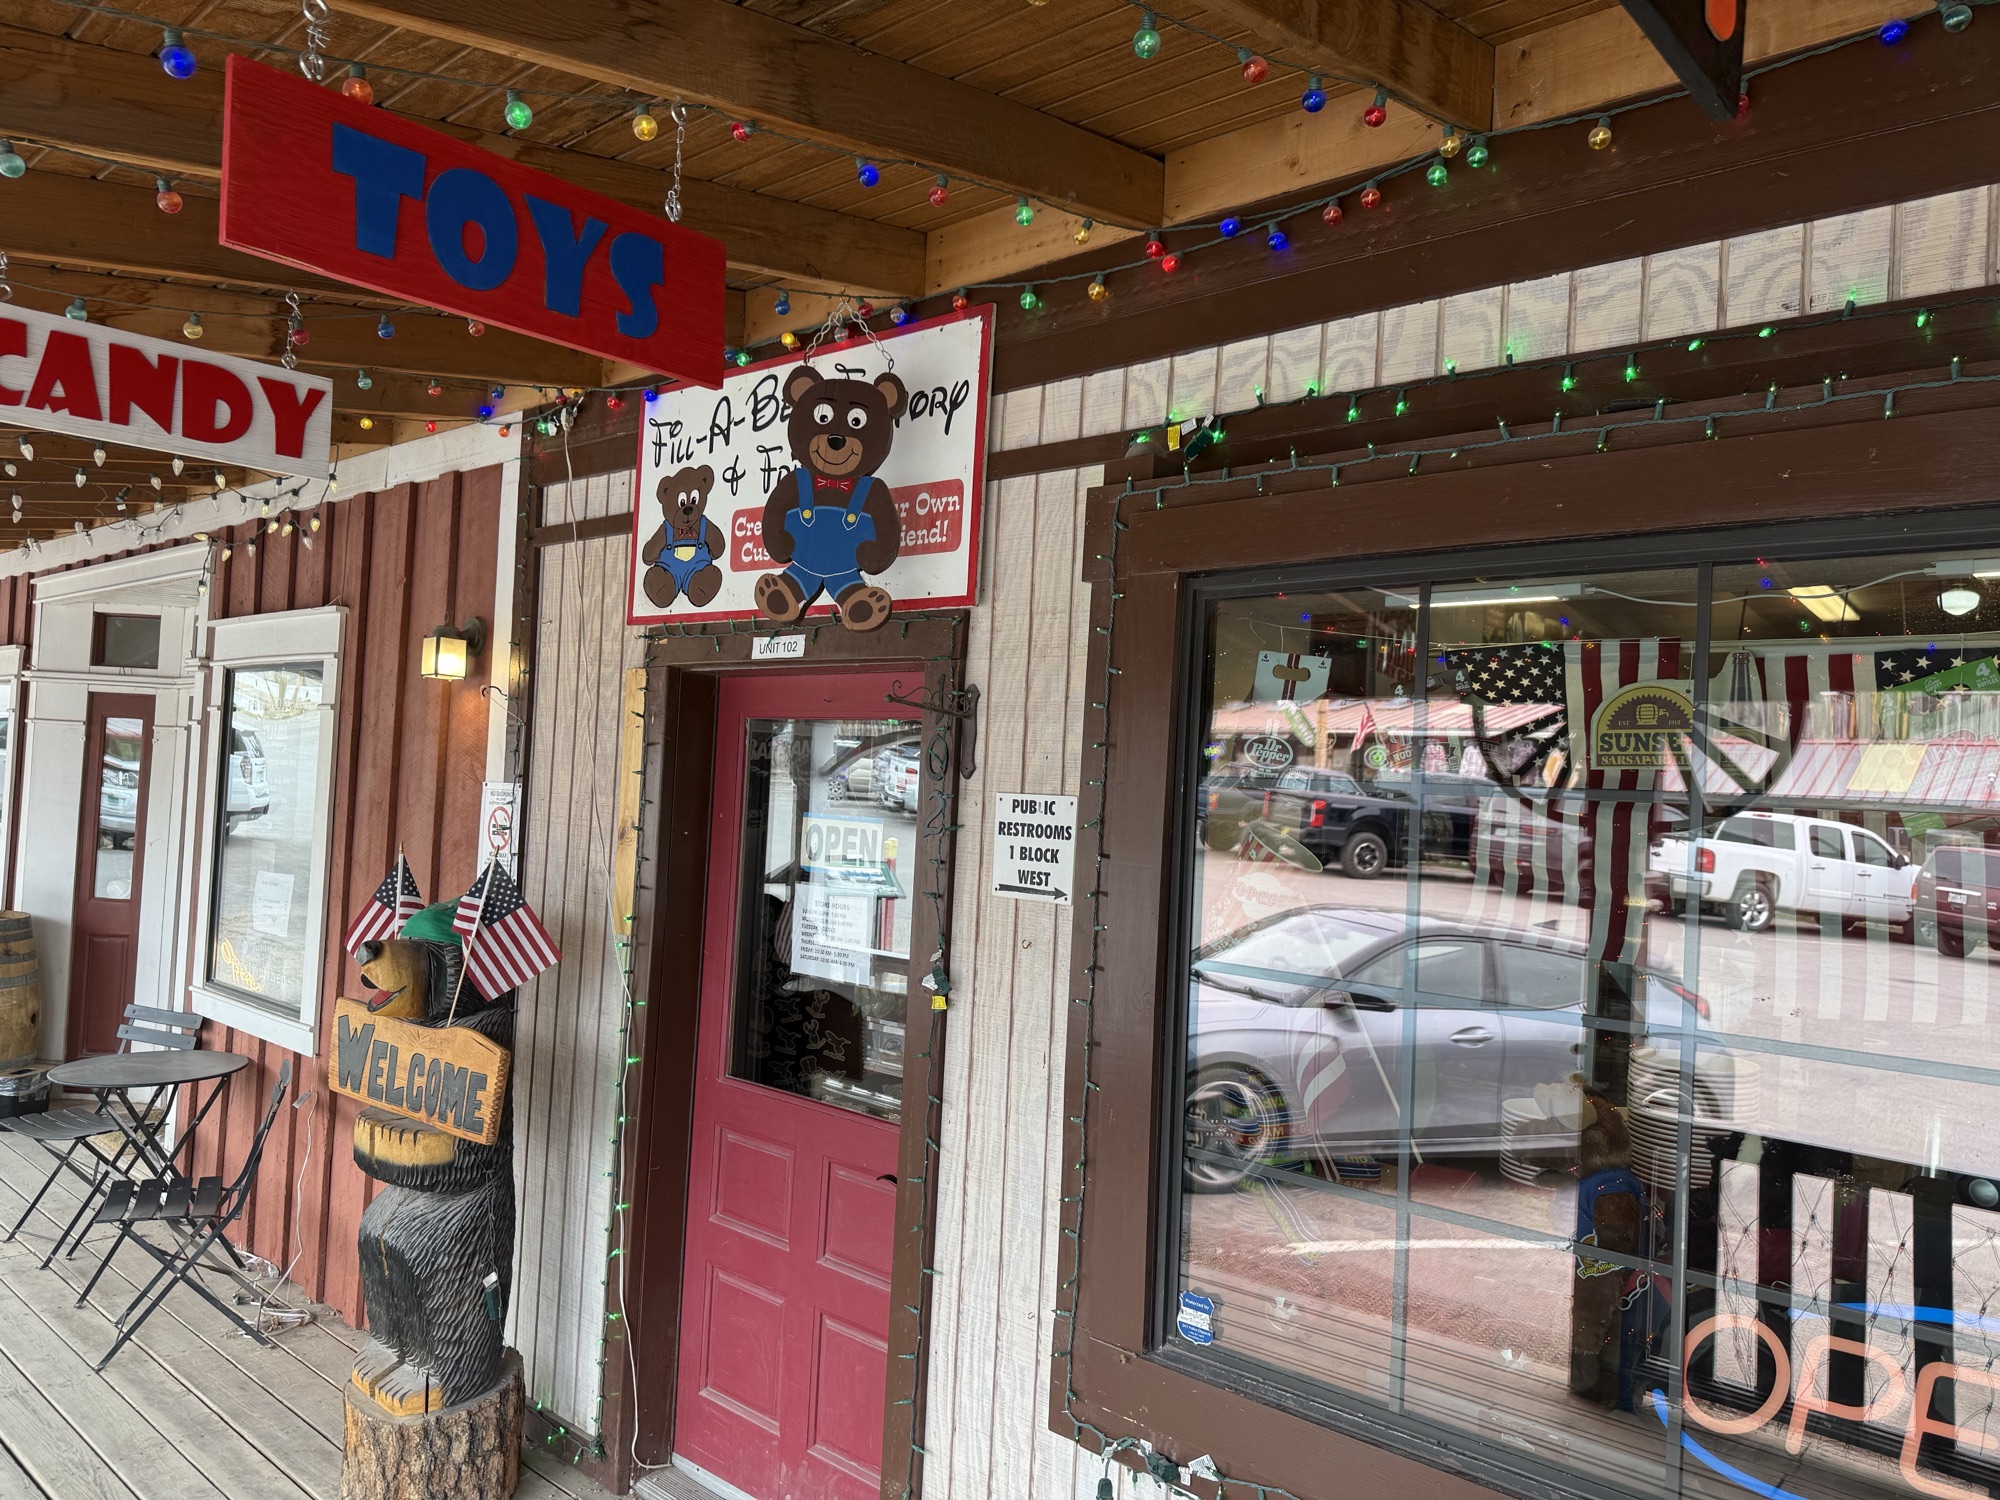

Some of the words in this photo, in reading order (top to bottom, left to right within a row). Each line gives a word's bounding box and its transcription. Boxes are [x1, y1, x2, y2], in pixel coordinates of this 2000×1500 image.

[332, 123, 664, 339] TOYS
[915, 492, 960, 516] Own
[734, 516, 763, 537] Cre
[900, 519, 949, 547] iend!
[741, 542, 771, 562] Cus
[759, 643, 781, 655] UNIT
[783, 641, 798, 653] 102
[1455, 670, 1465, 682] 4
[1975, 662, 1991, 677] 4
[1394, 684, 1404, 696] 4
[1249, 742, 1290, 764] Pepper
[1263, 738, 1282, 753] Dr
[1482, 741, 1499, 752] BEER
[1393, 748, 1413, 762] ROO
[998, 821, 1072, 841] RESTROOMS
[806, 823, 878, 868] OPEN
[1010, 845, 1014, 860] 1
[1020, 846, 1060, 863] BLOCK
[1018, 869, 1051, 887] WEST
[832, 901, 850, 910] HOURS
[338, 1014, 488, 1135] WELCOME
